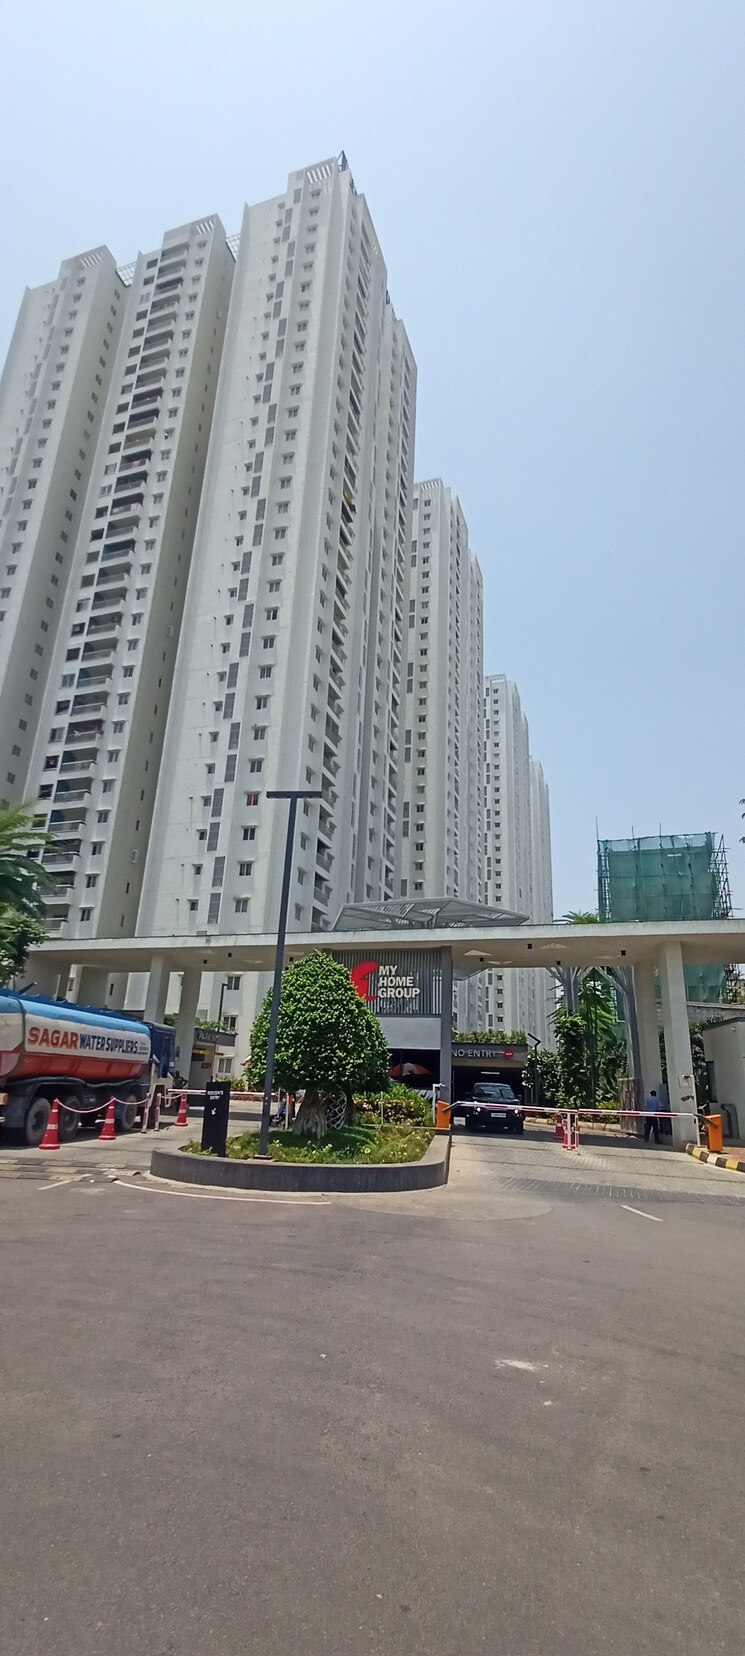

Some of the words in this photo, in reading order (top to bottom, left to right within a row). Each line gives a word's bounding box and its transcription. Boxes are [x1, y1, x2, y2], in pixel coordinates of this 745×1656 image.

[379, 965, 397, 975] MY
[379, 976, 414, 986] HOME
[379, 987, 420, 998] GROUP
[27, 1026, 79, 1049] SAGAR
[79, 1033, 106, 1051] WATER
[105, 1038, 138, 1054] SUPPLIERS
[451, 1048, 465, 1057] NO
[467, 1049, 496, 1058] ENTRY
